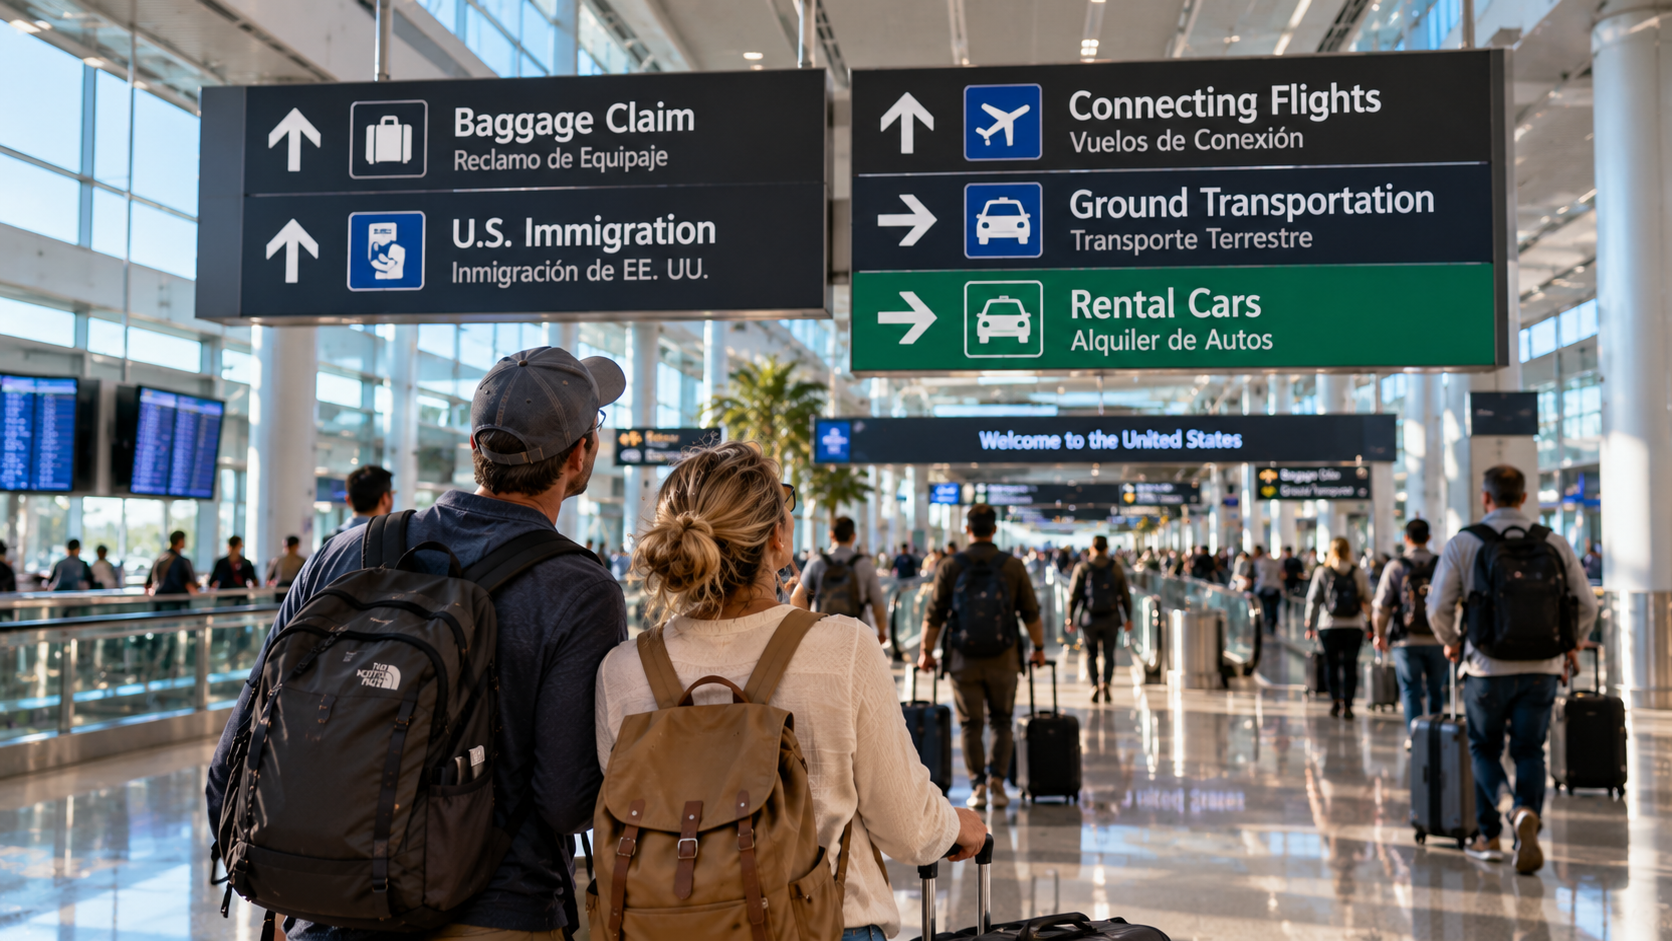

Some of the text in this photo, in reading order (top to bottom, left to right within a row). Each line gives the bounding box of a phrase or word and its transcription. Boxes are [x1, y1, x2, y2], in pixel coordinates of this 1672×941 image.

[1070, 82, 1381, 124] Connecting Flights
[454, 101, 694, 144] Baggage Claim
[1070, 126, 1303, 152] Vuelos de Conexión
[454, 145, 668, 173] Reclamo de Equipaje
[1070, 183, 1434, 222] Ground Transportation
[453, 214, 715, 254] U.S. Immigration
[1071, 227, 1312, 255] Transporte Terrestre
[453, 257, 708, 288] Inmigración de EE. UU.
[1072, 287, 1261, 319] Rental Cars
[1071, 328, 1273, 355] Alquiler de Autos
[979, 429, 1242, 450] Welcome to the United States
